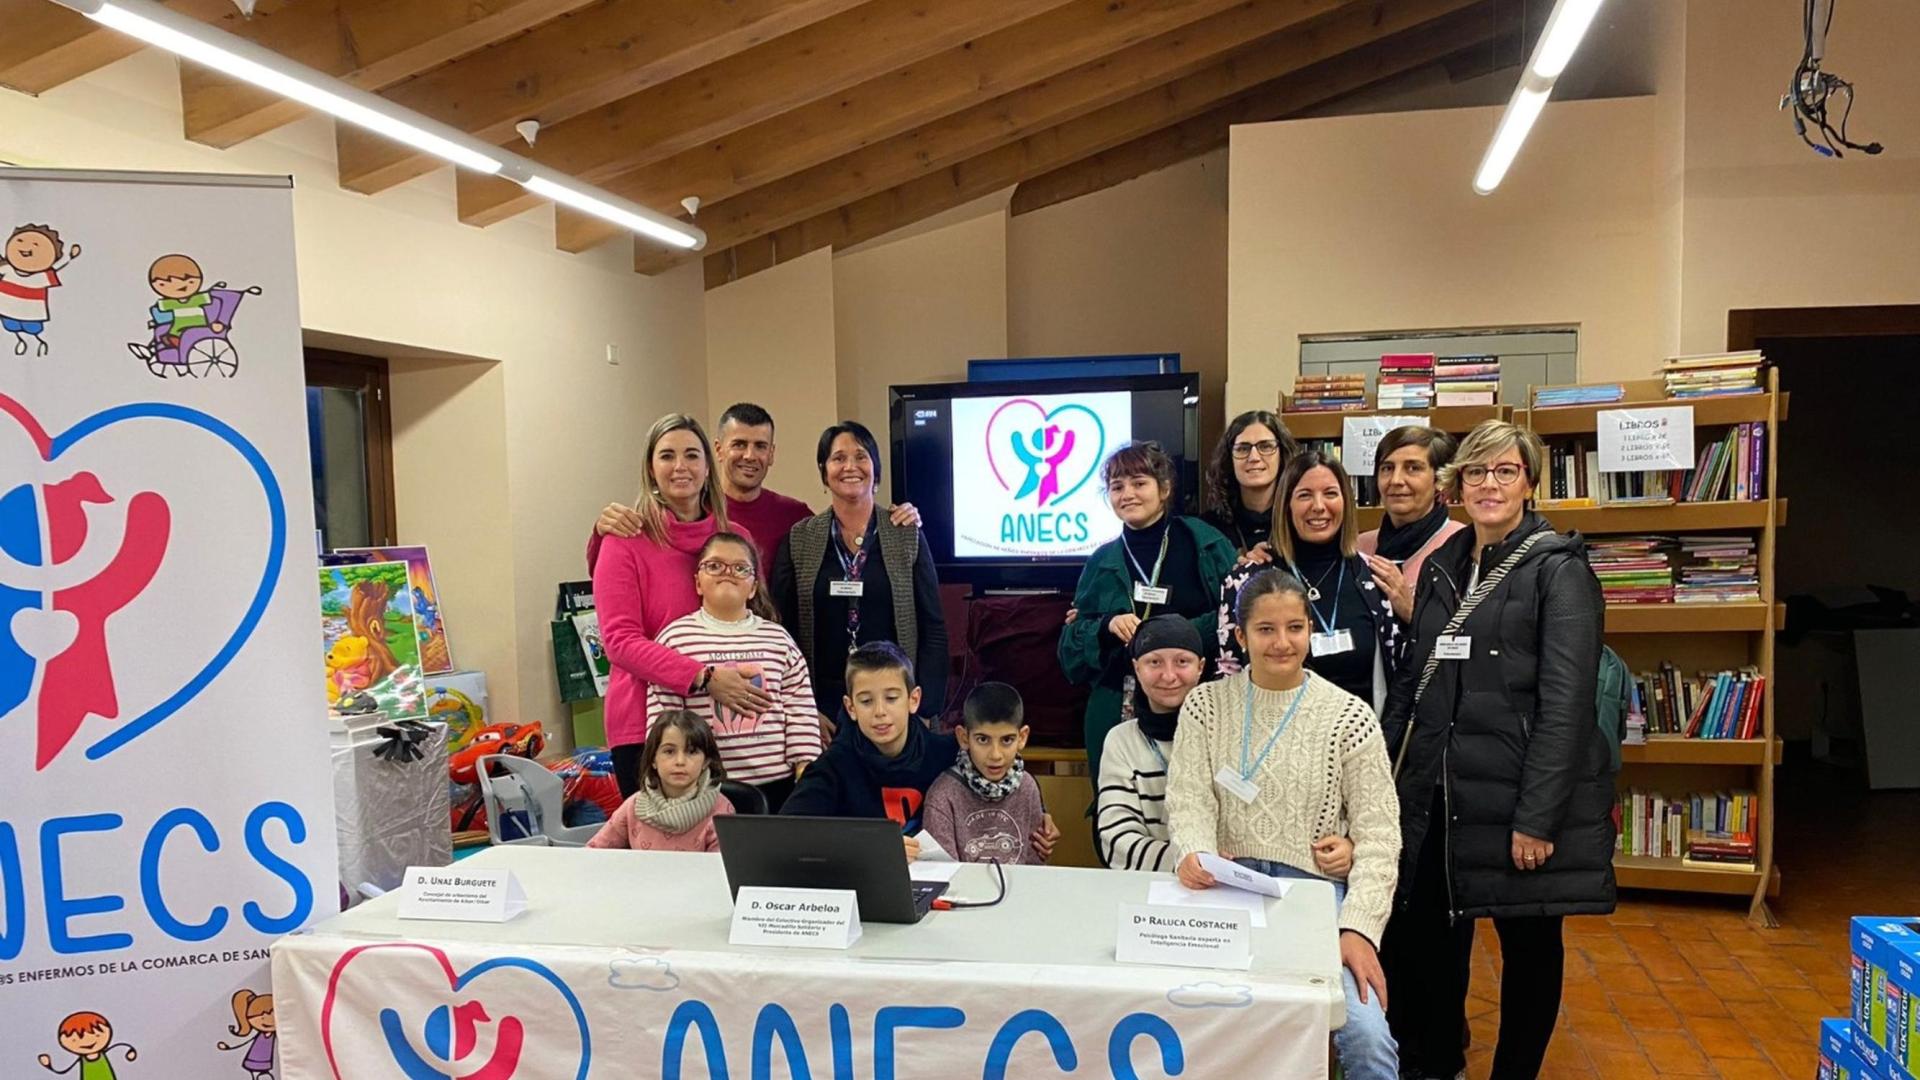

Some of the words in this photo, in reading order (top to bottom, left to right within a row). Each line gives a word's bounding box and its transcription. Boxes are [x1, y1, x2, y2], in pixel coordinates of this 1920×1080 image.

[1619, 420, 1660, 431] LIBROS
[1000, 511, 1089, 543] ANECS
[417, 876, 428, 885] D.
[454, 878, 497, 888] BURGUETE
[752, 901, 762, 910] D.
[765, 902, 796, 911] Oscar
[798, 902, 840, 913] Arbeloa
[1149, 916, 1186, 927] RALUCA
[1188, 919, 1238, 930] COSTACHE
[18, 964, 94, 983] ENFERMOS
[99, 962, 116, 974] DE
[121, 960, 138, 972] LA
[142, 953, 218, 970] COMARCA
[222, 950, 239, 963] DE
[243, 948, 270, 960] SAN
